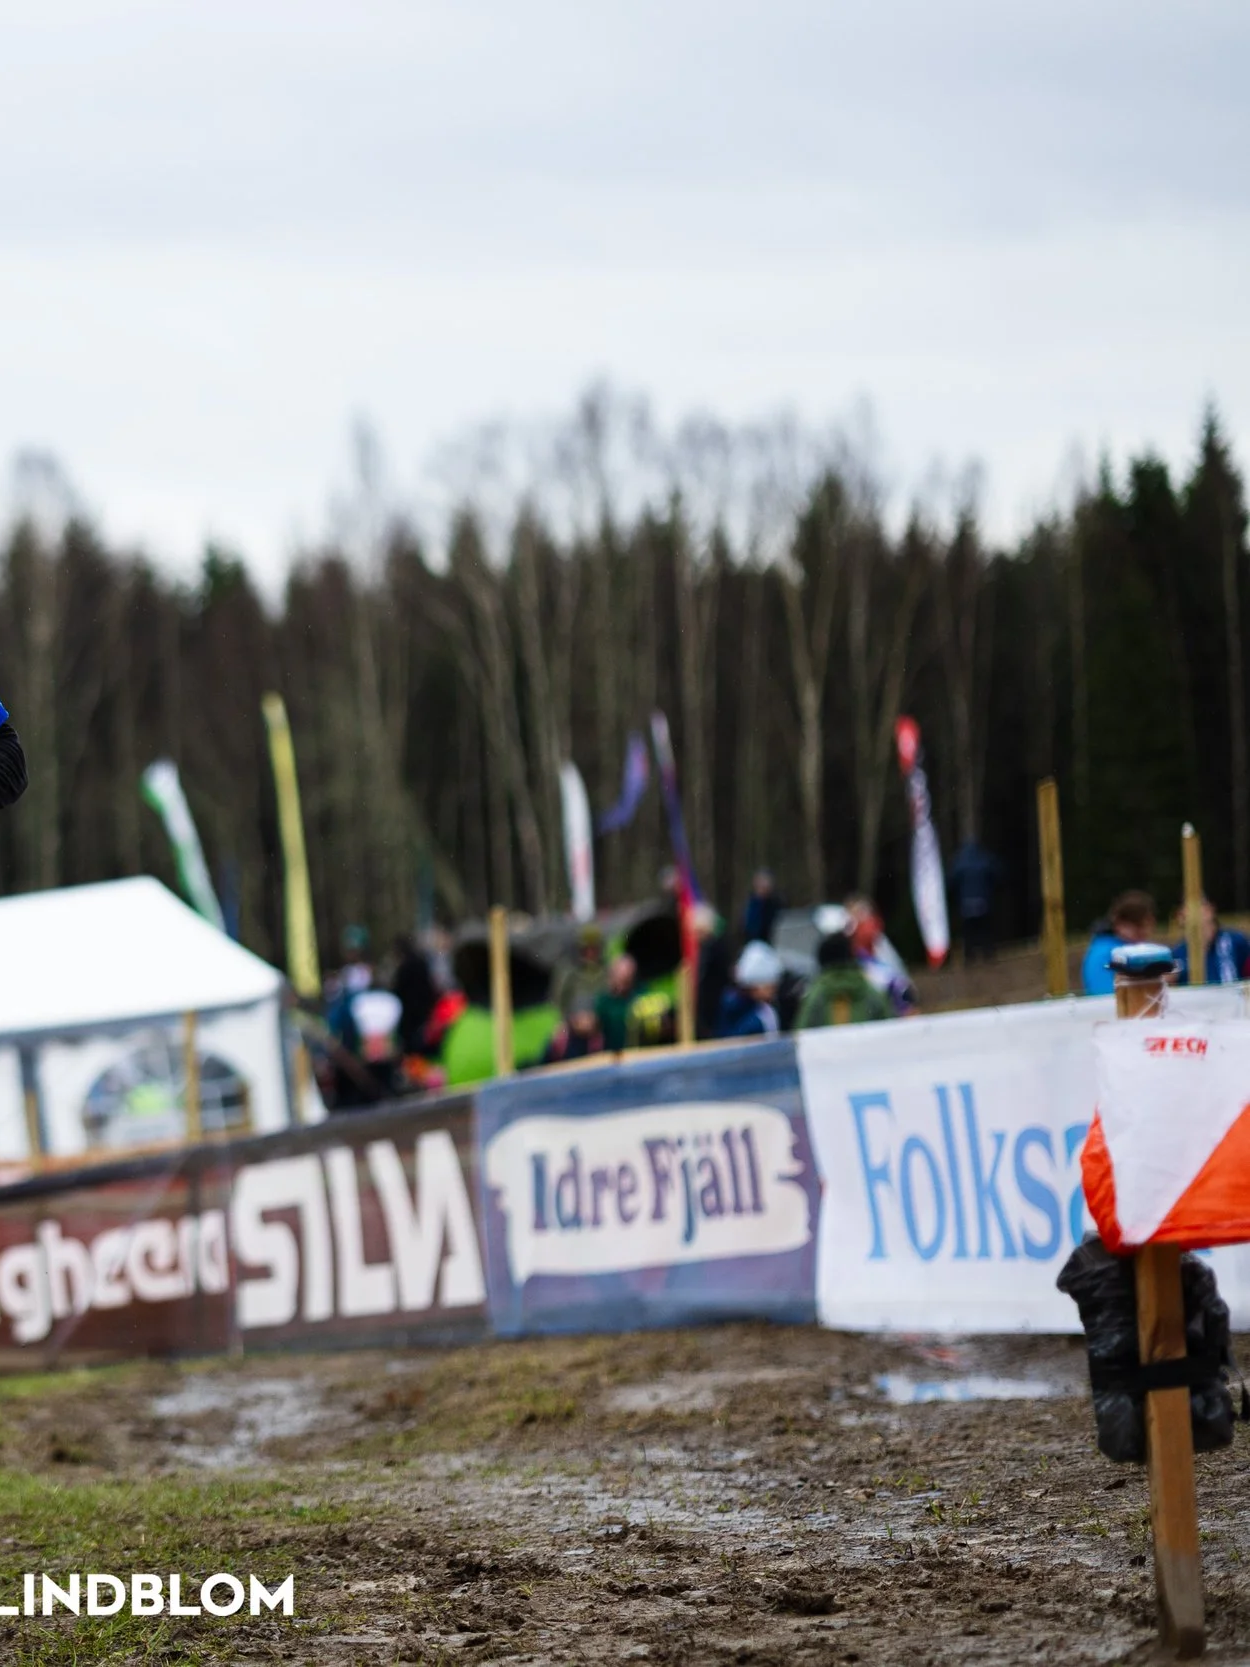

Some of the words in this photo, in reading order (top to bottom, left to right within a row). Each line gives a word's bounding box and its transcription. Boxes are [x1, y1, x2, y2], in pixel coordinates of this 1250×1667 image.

[230, 1128, 487, 1330] SILVA
[530, 1144, 639, 1232] Idre
[644, 1124, 766, 1246] Fjäll
